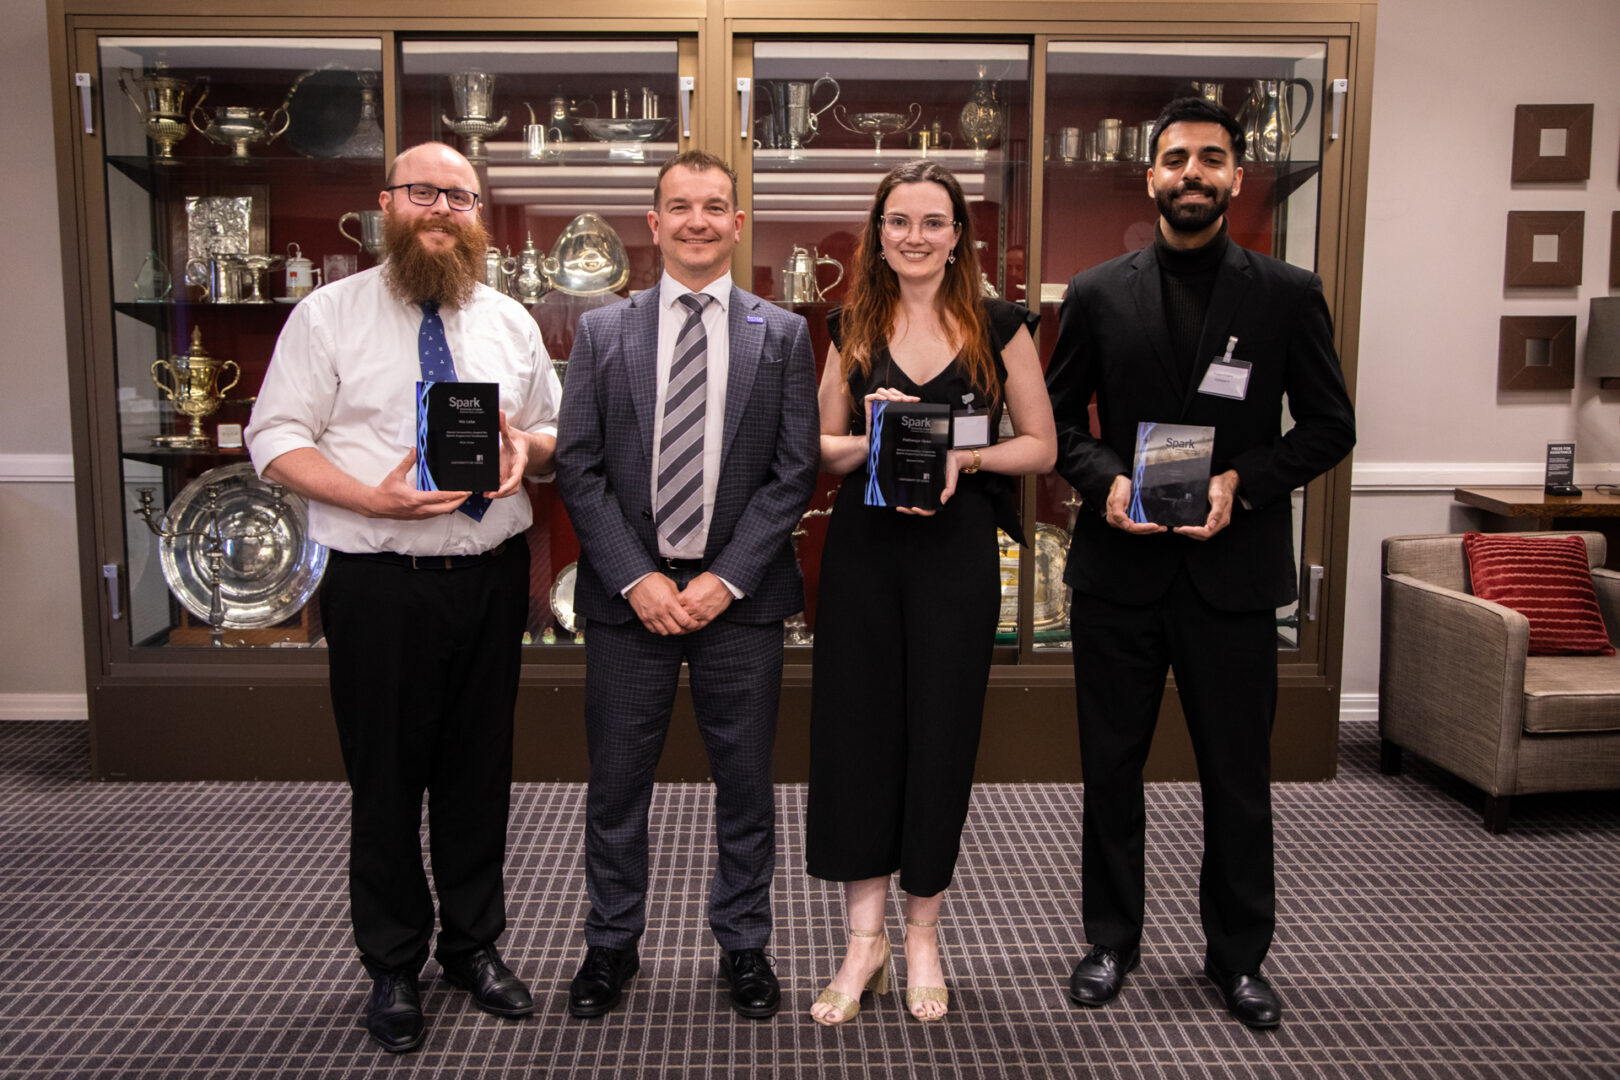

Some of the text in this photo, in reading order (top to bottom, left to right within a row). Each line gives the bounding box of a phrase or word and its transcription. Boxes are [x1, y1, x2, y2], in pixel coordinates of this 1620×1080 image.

[449, 396, 480, 409] Spark
[901, 416, 931, 428] Spark
[1166, 437, 1195, 449] Spark
